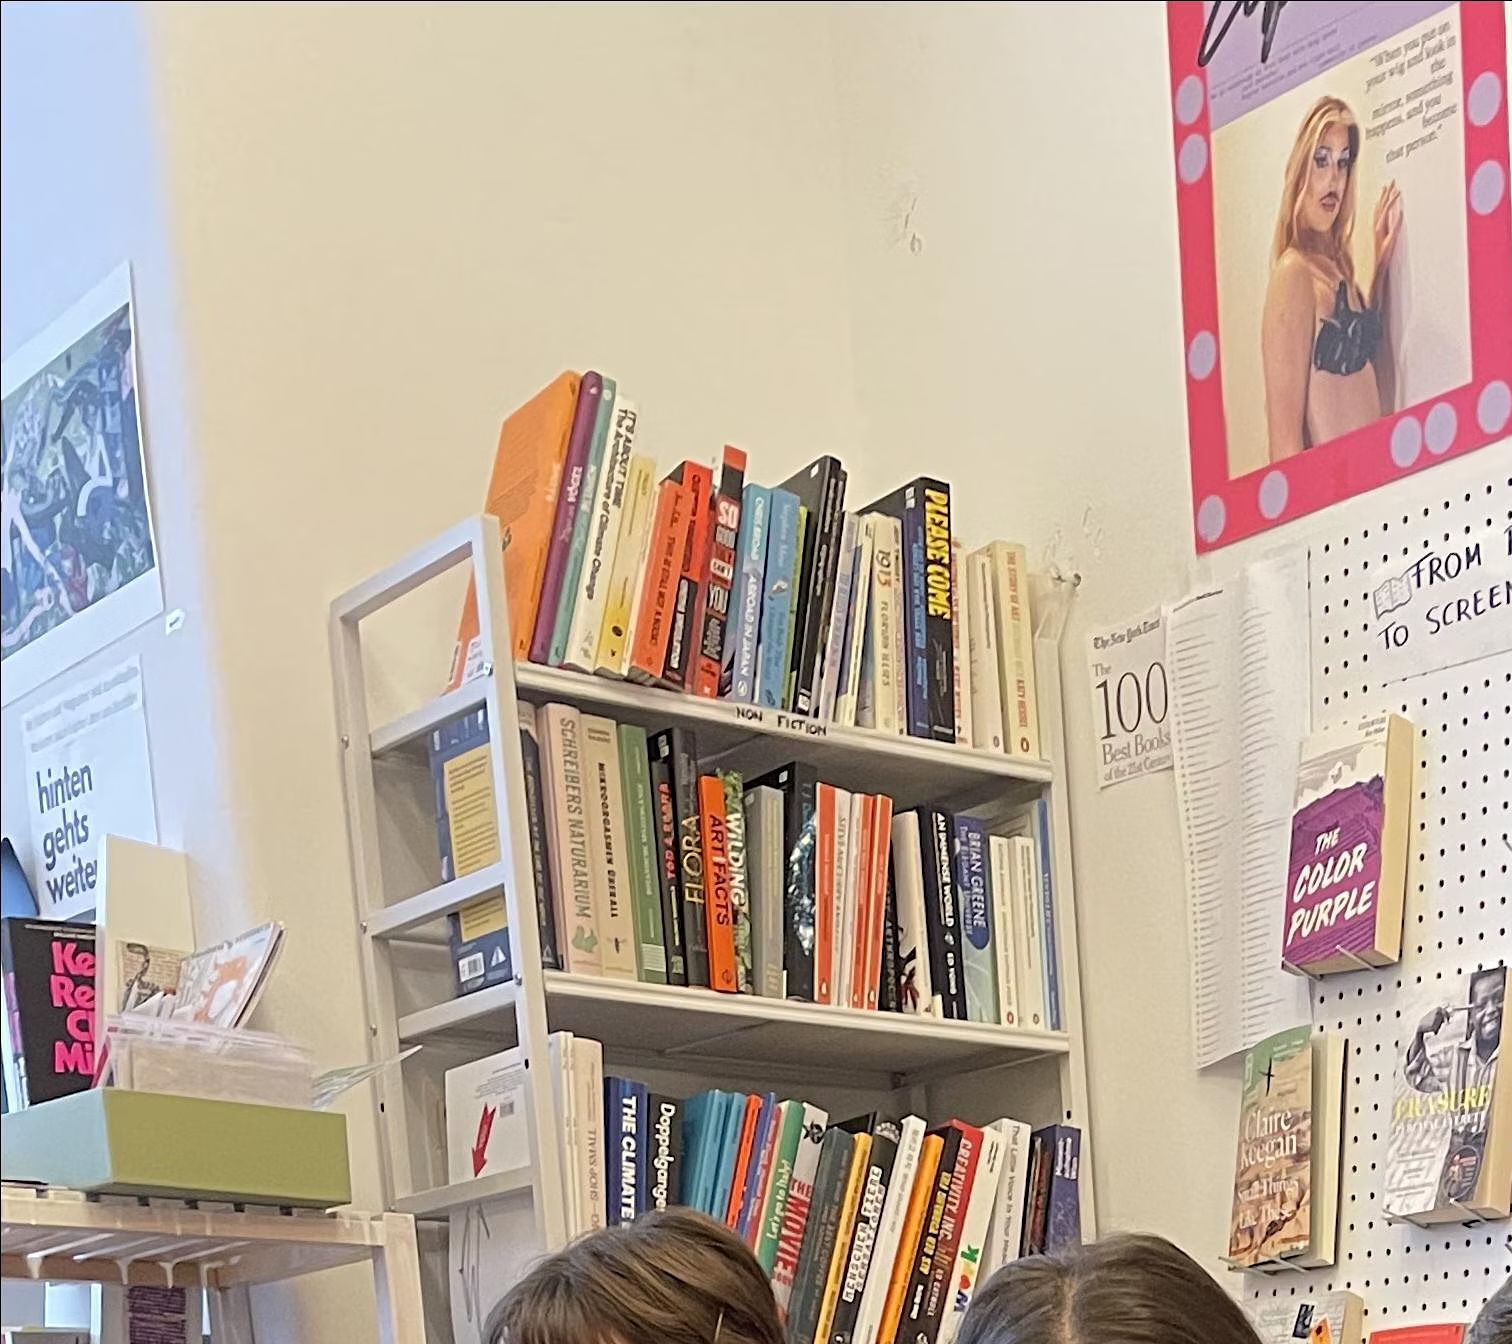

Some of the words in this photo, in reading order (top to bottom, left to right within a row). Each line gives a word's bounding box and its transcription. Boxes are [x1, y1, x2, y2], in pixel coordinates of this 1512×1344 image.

[924, 488, 949, 568] PLEASE
[874, 548, 891, 588] 1913
[1409, 543, 1482, 589] FROM
[743, 574, 760, 622] ABROAD
[926, 566, 950, 620] COME
[742, 623, 754, 635] IN
[1377, 621, 1410, 650] TO
[738, 635, 753, 676] JAPAN
[1092, 662, 1112, 678] The
[736, 707, 763, 722] NON
[777, 715, 827, 736] FICTION
[1095, 662, 1168, 740] 100
[560, 717, 584, 815] SCHREIBERS
[1102, 742, 1131, 765] Best
[1134, 727, 1172, 756] Books
[36, 764, 93, 814] hinten
[598, 762, 614, 868] MIKROORGASMEN
[937, 812, 946, 830] AN
[43, 808, 90, 871] gehts
[682, 816, 704, 904] FLORA
[726, 813, 746, 907] WILDING
[938, 831, 952, 883] IMMENSE
[968, 831, 983, 873] BRIAN
[1315, 827, 1341, 855] THE
[568, 818, 592, 919] NATURARIUM
[709, 814, 730, 926] ARTIFACTS
[1293, 842, 1368, 904] COLOR
[943, 883, 955, 927] WORLD
[970, 874, 987, 929] GREENE
[1286, 880, 1376, 946] PURPLE
[947, 952, 956, 967] ED
[622, 1096, 637, 1134] THE
[1245, 1109, 1292, 1143] Claire
[652, 1102, 676, 1213] Doppelgange
[1240, 1132, 1298, 1169] Keegan
[621, 1136, 637, 1219] CLIMATE
[778, 1187, 786, 1202] to
[767, 1214, 779, 1240] Let's
[775, 1201, 785, 1218] go
[775, 1187, 810, 1277] MOVIE
[844, 1222, 869, 1301] MENSCHEN
[861, 1165, 883, 1216] TIERE
